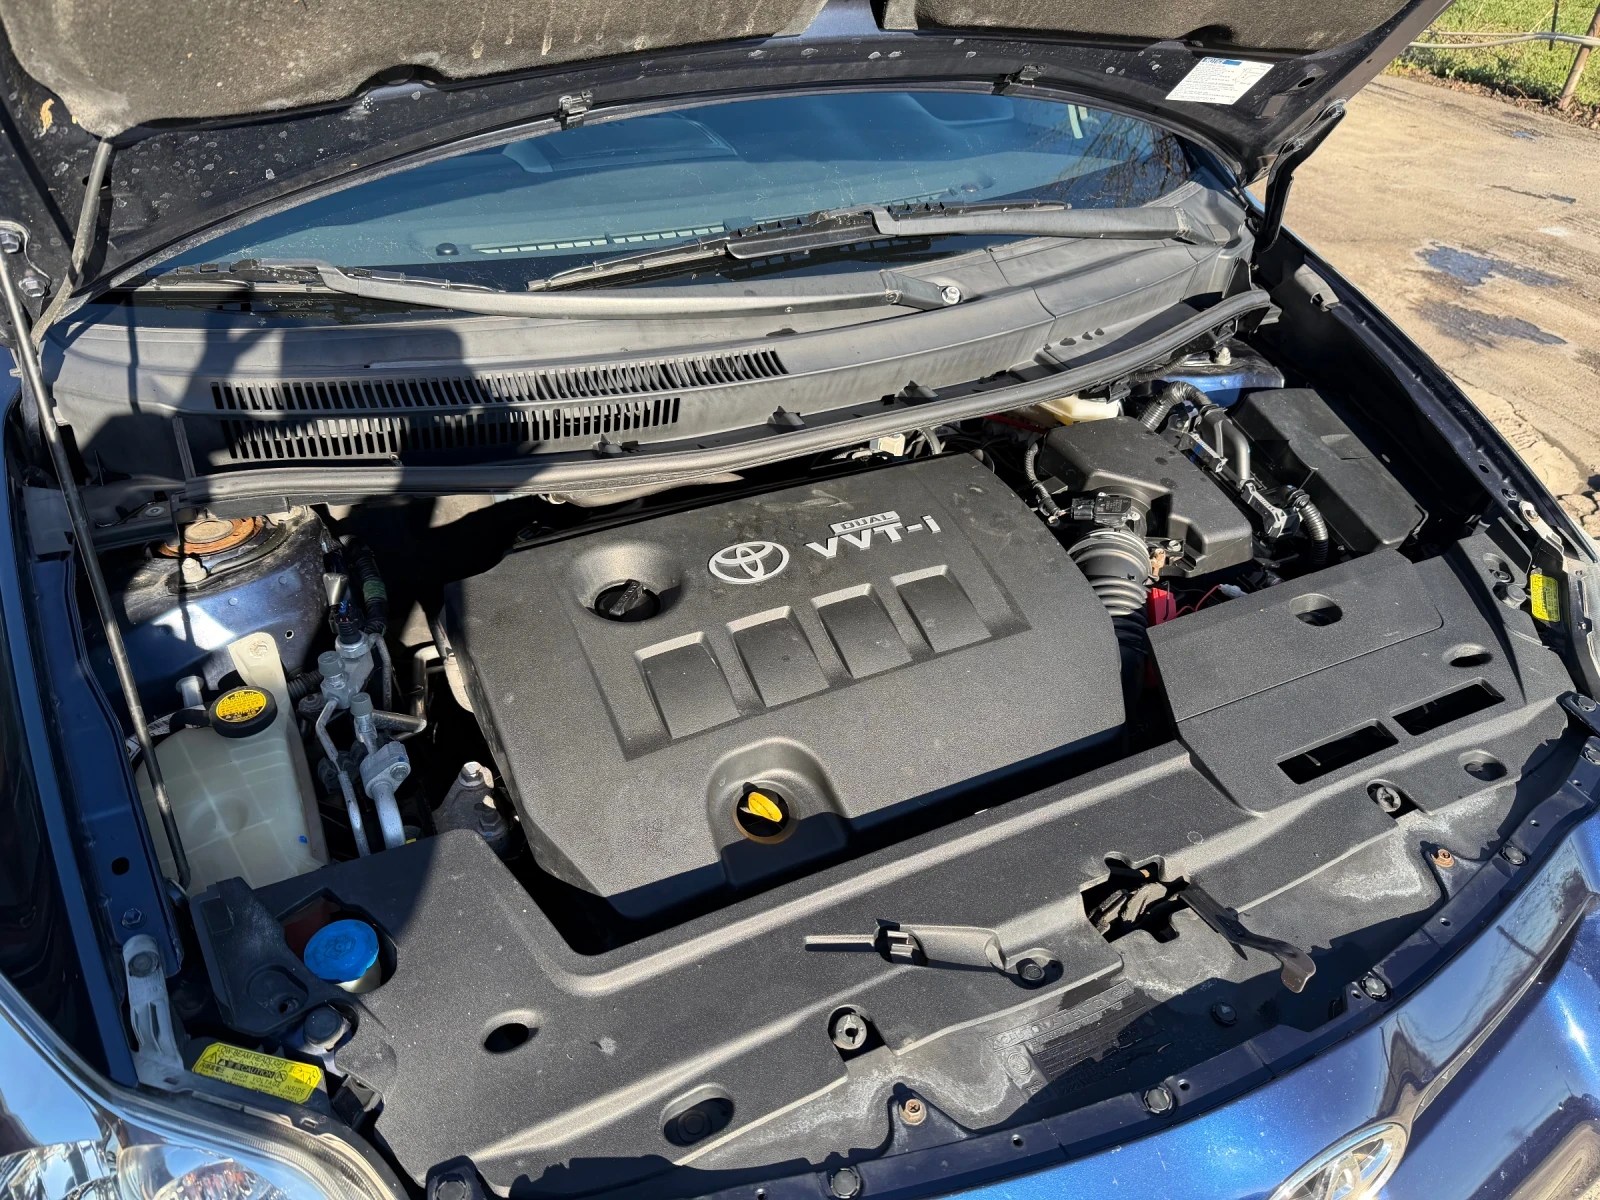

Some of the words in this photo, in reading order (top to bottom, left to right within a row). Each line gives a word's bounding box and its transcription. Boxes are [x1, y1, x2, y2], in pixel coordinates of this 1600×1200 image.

[840, 514, 894, 530] DUAL
[217, 1045, 252, 1060] LOW-BEAM
[240, 1065, 275, 1078] CAUTION
[233, 1071, 249, 1080] HIGH
[252, 1076, 281, 1088] VOLTAGE
[285, 1085, 306, 1095] INSIDE
